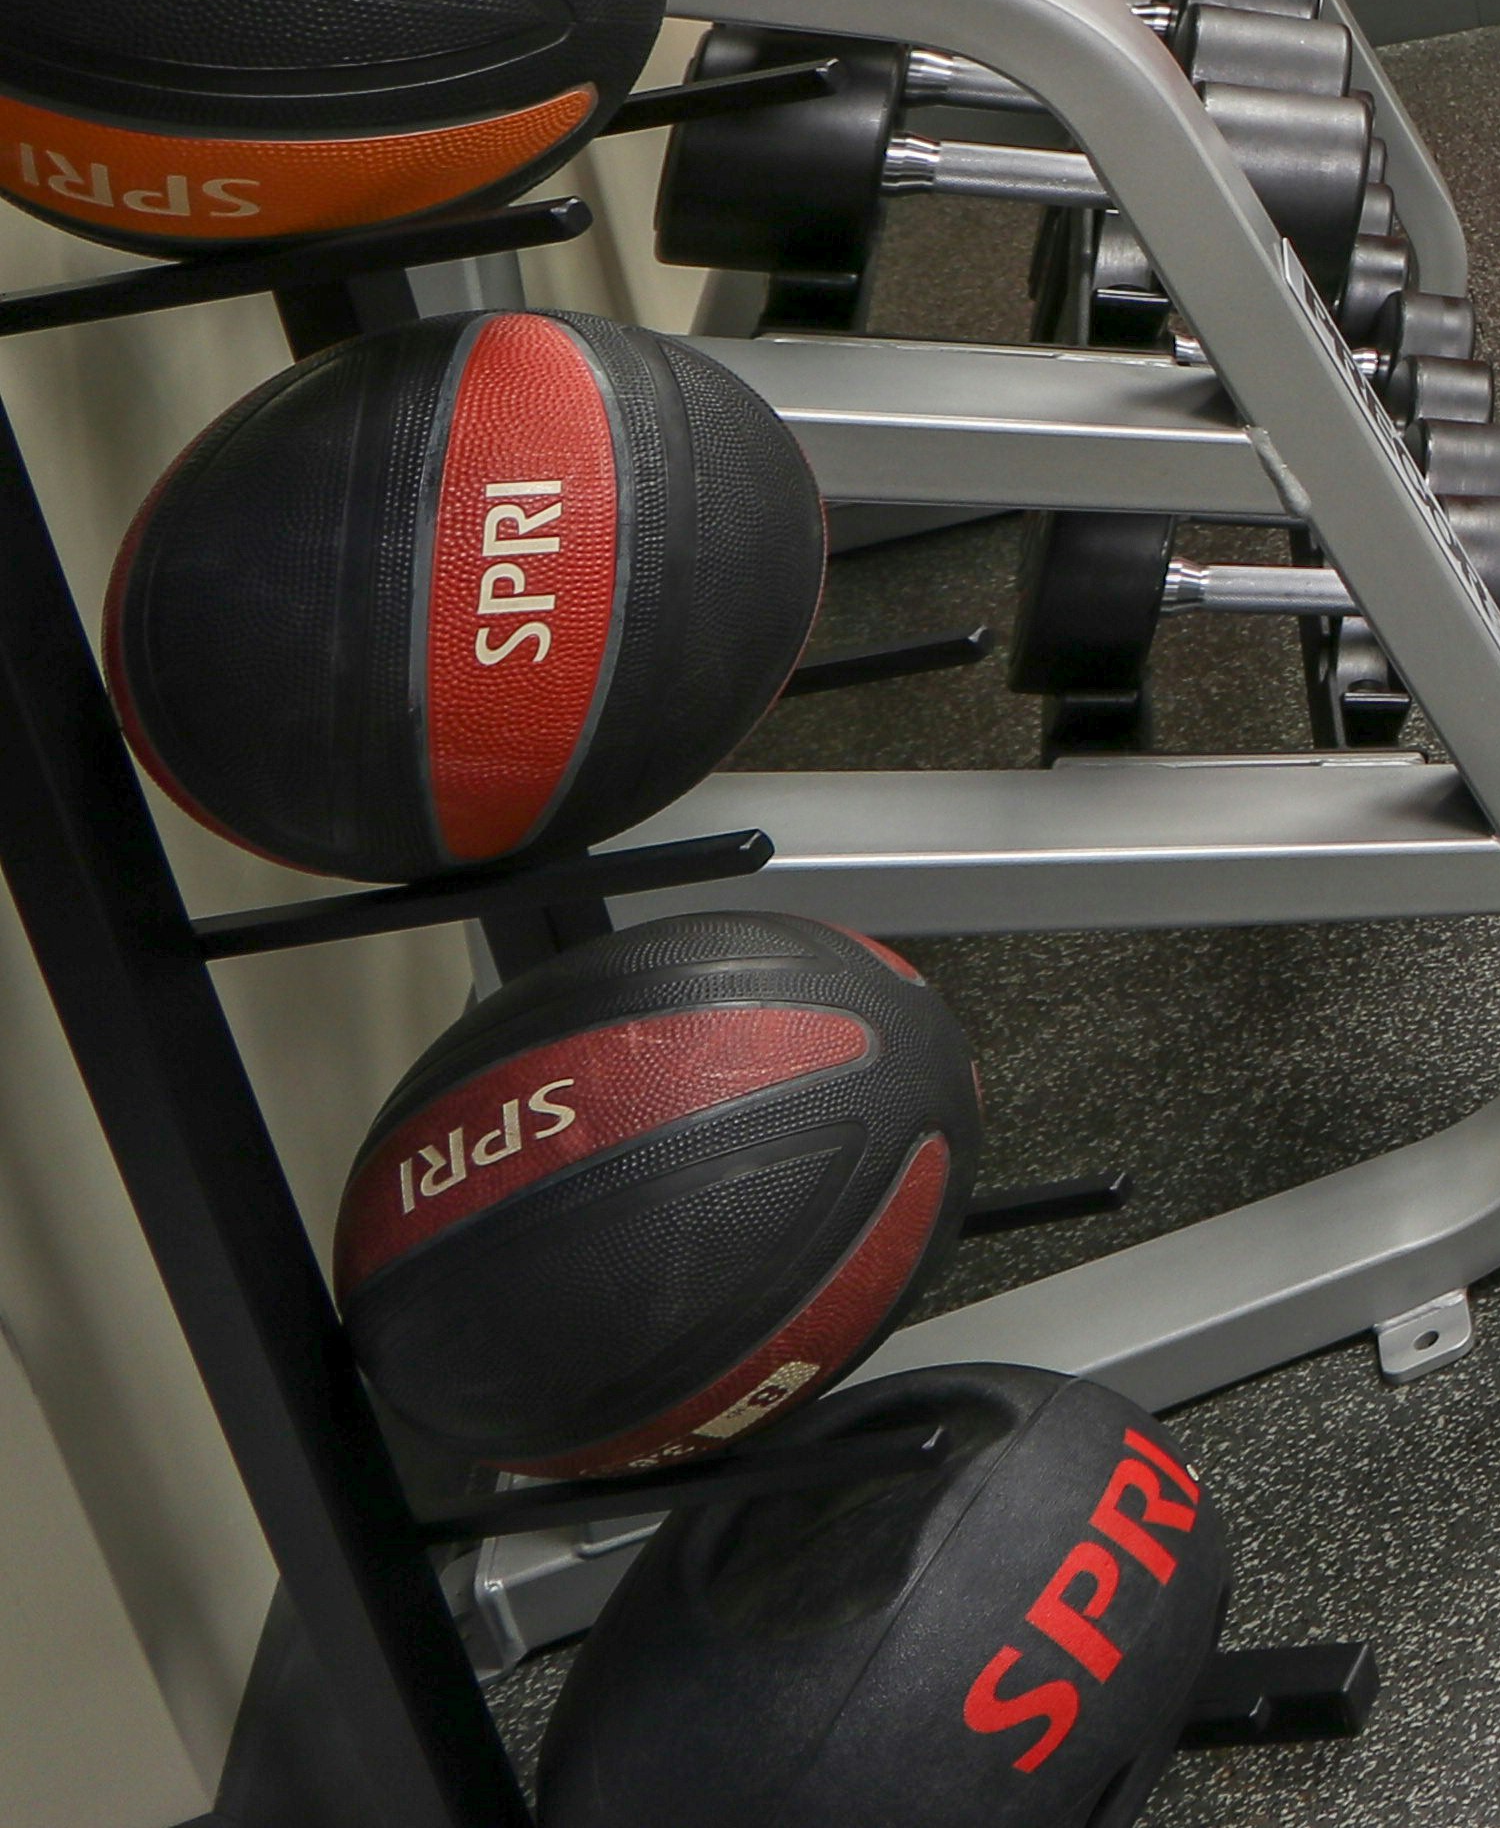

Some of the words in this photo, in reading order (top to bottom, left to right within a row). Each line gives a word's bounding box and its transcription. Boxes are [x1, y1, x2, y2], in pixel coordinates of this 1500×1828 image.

[19, 142, 261, 218] SPRI
[474, 479, 563, 666] SPRI
[399, 1077, 577, 1216] SPRI
[963, 1425, 1201, 1773] SPRI
